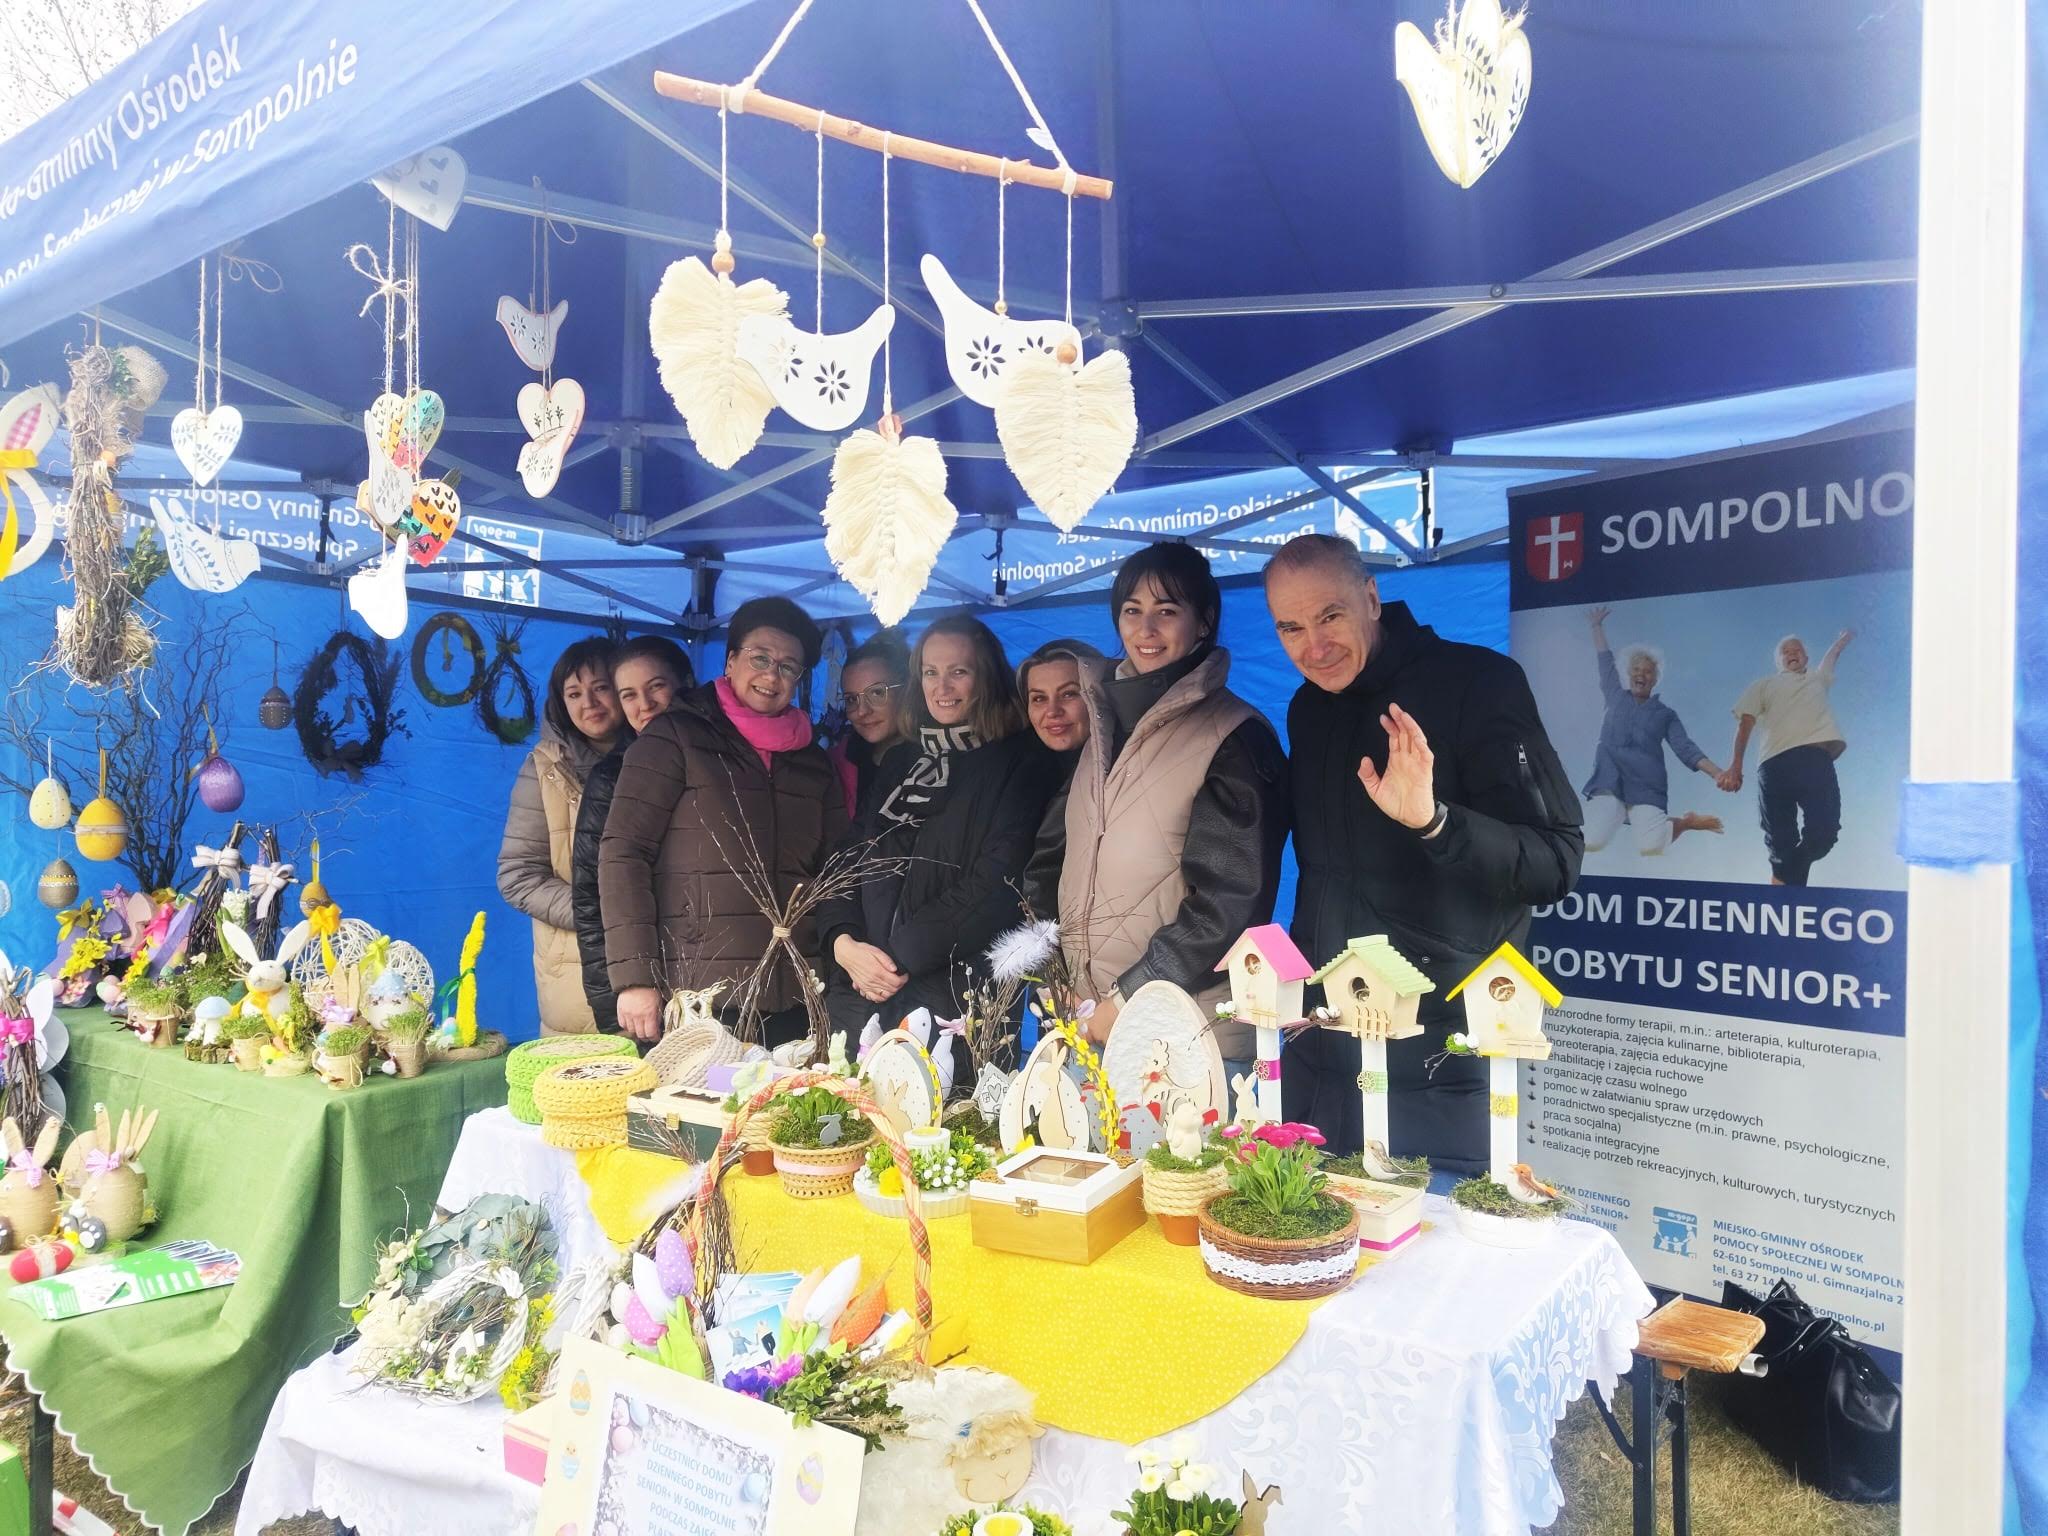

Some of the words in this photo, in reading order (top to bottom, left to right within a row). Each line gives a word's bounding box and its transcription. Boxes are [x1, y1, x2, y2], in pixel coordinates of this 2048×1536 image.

[117, 25, 243, 141] Ośrodek
[183, 38, 359, 174] Sompolnie
[1601, 471, 1914, 555] SOMPOLNO
[1637, 895, 1894, 945] DZIENNEGO
[1532, 945, 1683, 988] POBYTU
[1697, 960, 1892, 1009] SENIOR+
[1544, 1021, 1623, 1042] muzykoterapia,
[1626, 1032, 1664, 1047] zajęcia
[1667, 1037, 1724, 1056] kulinarne,
[1727, 1045, 1805, 1068] biblioterapia,
[1546, 1036, 1618, 1057] horeoterapia,
[1621, 1046, 1659, 1061] zajęcia
[1662, 1054, 1728, 1073] edukacyjne
[1605, 1013, 1636, 1029] formy
[1715, 1028, 1783, 1048] arteterapia,
[1787, 1037, 1881, 1062] kulturoterapia,
[1543, 1065, 1603, 1084] organizację
[1605, 1077, 1637, 1089] czasu
[1640, 1081, 1688, 1099] wolnego
[1547, 1050, 1605, 1070] ehabilitację
[1614, 1061, 1652, 1077] zajęcia
[1655, 1067, 1704, 1084] ruchowe
[1543, 1080, 1577, 1095] pomoc
[1580, 1087, 1589, 1096] w
[1592, 1088, 1651, 1107] załatwianiu
[1655, 1099, 1690, 1114] spraw
[1692, 1106, 1764, 1127] urzędowych
[1543, 1109, 1571, 1123] praca
[1574, 1115, 1622, 1134] socjalna)
[1543, 1095, 1605, 1114] poradnictwo
[1608, 1106, 1692, 1131] specjalistyczne
[1731, 1129, 1780, 1148] prawne,
[1784, 1138, 1890, 1169] psychologiczne,
[1543, 1124, 1592, 1143] spotkania
[1594, 1135, 1660, 1156] integracyjne
[1542, 1138, 1591, 1158] realizację
[1594, 1149, 1634, 1166] potrzeb
[1637, 1158, 1719, 1186] rekreacyjnych,
[1723, 1174, 1800, 1202] kulturowych,
[1804, 1193, 1896, 1222] turystycznych
[1578, 1188, 1631, 1208] DZIENNEGO
[1590, 1204, 1629, 1221] SENIOR+
[1713, 1219, 1807, 1250] MIEJSKO-GMINNY
[1810, 1242, 1864, 1264] OŚRODEK
[1713, 1234, 1759, 1253] POMOCY
[1762, 1246, 1828, 1271] SPOŁECZNEJ
[1830, 1262, 1843, 1274] W
[1712, 1264, 1729, 1276] tel.
[1730, 1268, 1743, 1280] 63
[1746, 1272, 1759, 1283] 27
[1762, 1275, 1775, 1287] 14
[1713, 1249, 1747, 1266] 62-610
[1749, 1258, 1803, 1280] Sompolno
[1806, 1273, 1820, 1284] ul.
[1823, 1276, 1893, 1303] Gimnazjalna
[647, 1459, 694, 1490] DZIENNEGO
[695, 1482, 733, 1507] POBYTU
[652, 1439, 701, 1471] UCZESTNICY
[702, 1464, 733, 1486] DOMU
[637, 1475, 671, 1498] SENIOR+
[673, 1491, 683, 1505] W
[683, 1497, 737, 1531] SOMPOLNIE
[650, 1501, 688, 1530] PODCZAS
